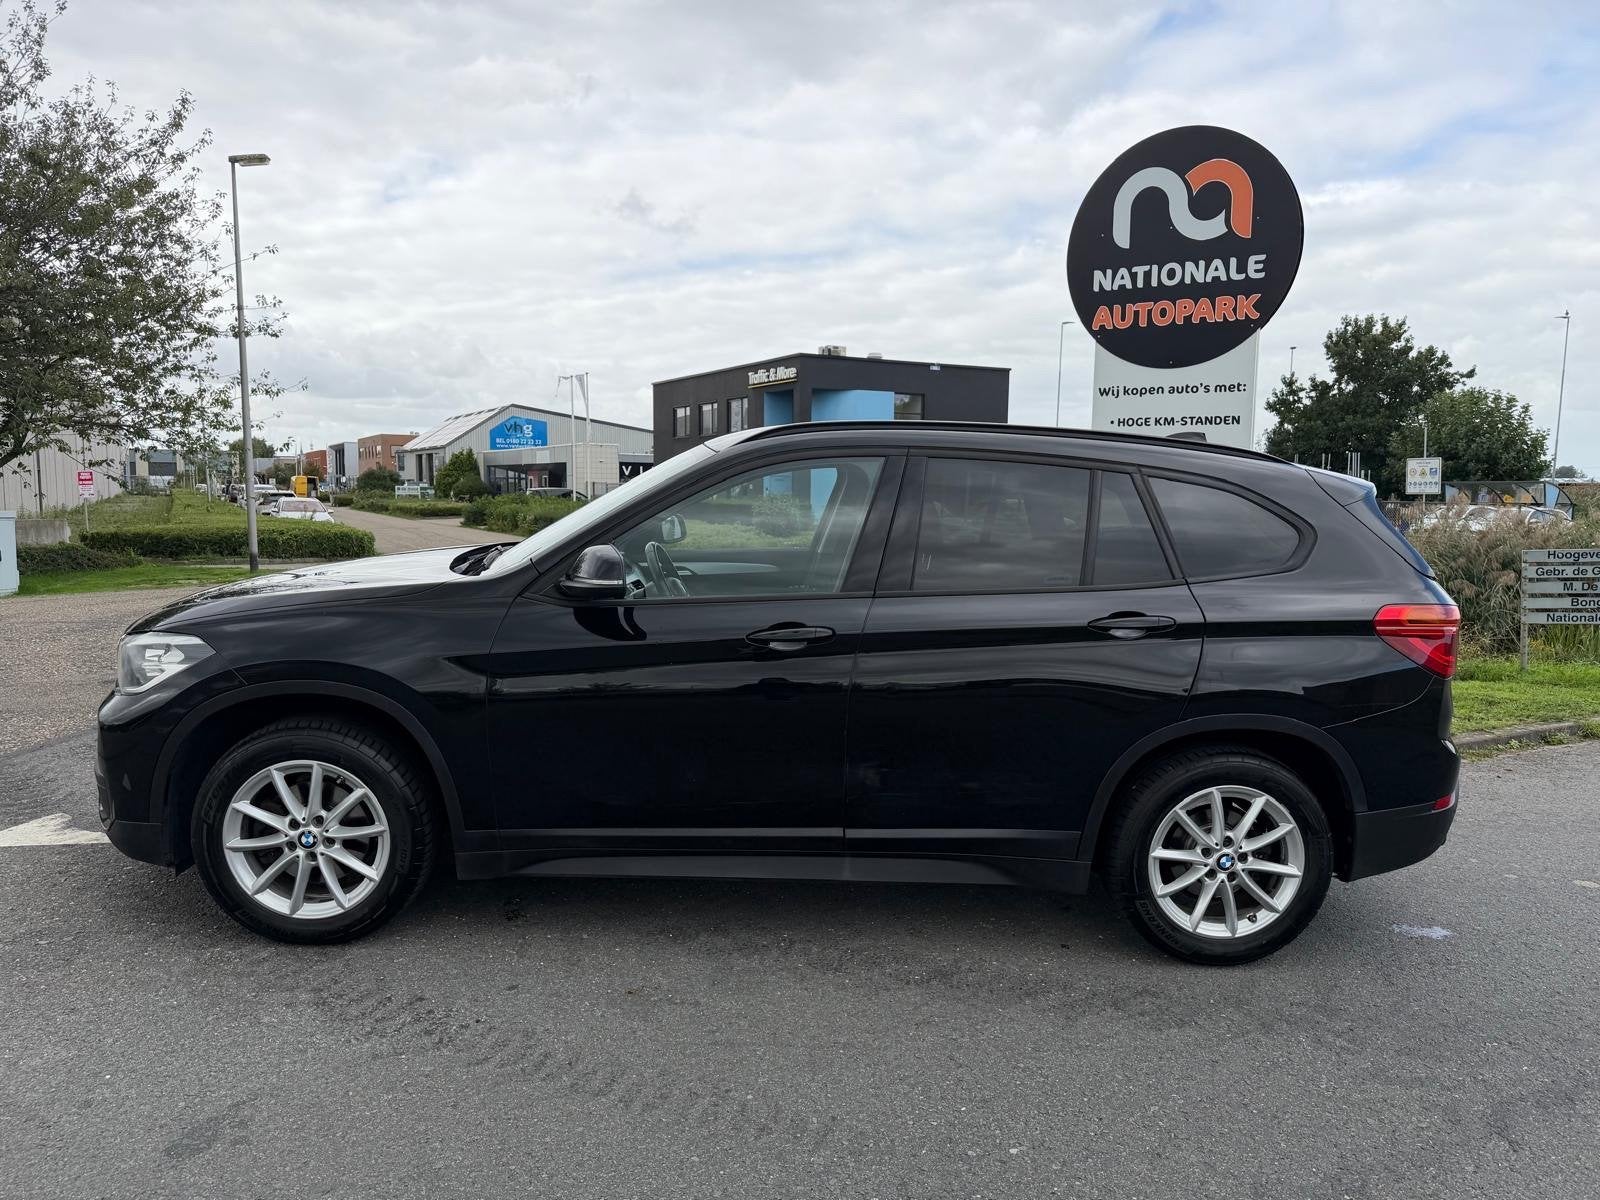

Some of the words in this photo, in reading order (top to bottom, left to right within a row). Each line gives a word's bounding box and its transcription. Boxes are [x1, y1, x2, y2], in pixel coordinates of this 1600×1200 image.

[1093, 254, 1267, 292] NATIONALE
[1092, 294, 1261, 331] AUTOPARK
[777, 366, 797, 380] More
[1099, 386, 1120, 398] Wij
[1123, 385, 1164, 398] kopen
[1168, 382, 1210, 394] auto's
[1214, 382, 1247, 393] met:
[1117, 417, 1150, 427] HOGE
[1154, 415, 1241, 427] KM-STANDEN
[504, 421, 533, 437] vhg
[1536, 567, 1568, 576] Gebr.
[1572, 567, 1588, 576] de
[1563, 582, 1577, 591] M.
[1582, 582, 1599, 591] De
[1546, 613, 1600, 622] National
